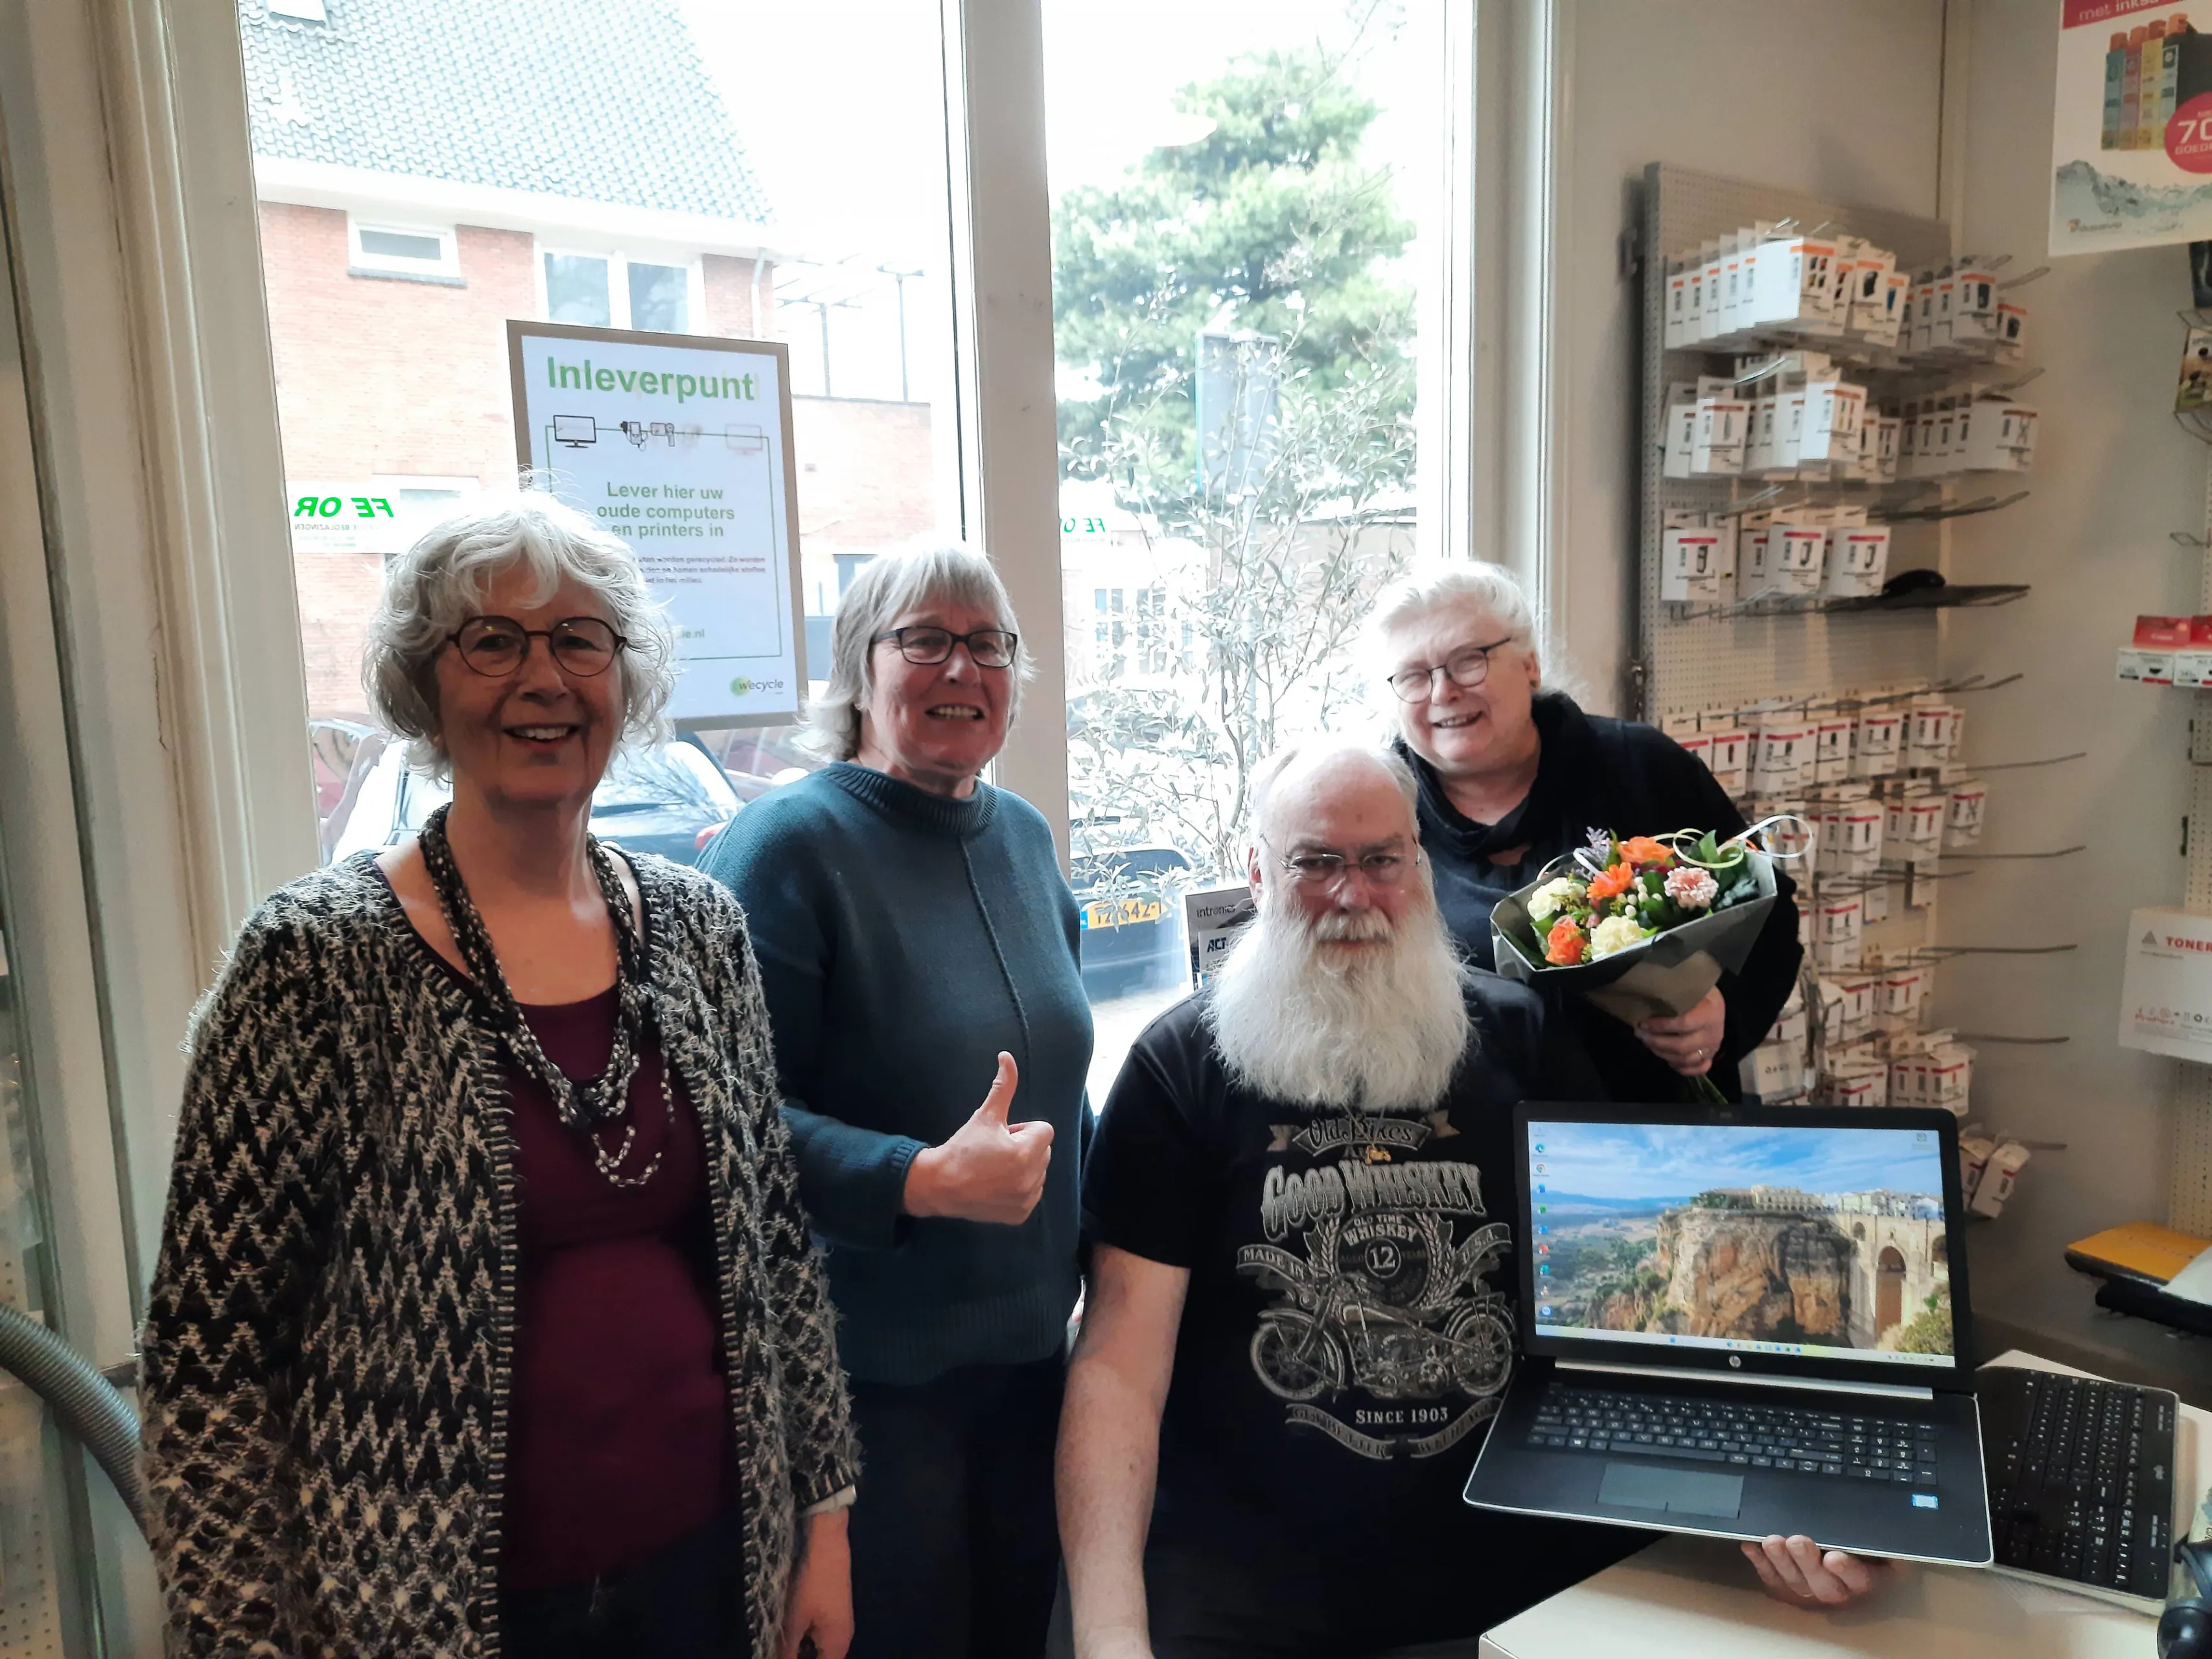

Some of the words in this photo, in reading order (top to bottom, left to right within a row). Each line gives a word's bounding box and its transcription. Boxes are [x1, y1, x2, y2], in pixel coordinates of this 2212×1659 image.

[2079, 5, 2111, 21] met
[547, 356, 755, 404] Inleverpunt
[607, 481, 658, 498] Lever
[664, 484, 697, 499] hier
[701, 487, 723, 499] uw
[596, 504, 640, 518] oude
[647, 505, 735, 521] computers
[611, 524, 632, 537] en
[638, 523, 703, 539] printers
[709, 523, 724, 537] in
[739, 679, 784, 692] wecycle
[1207, 936, 1227, 953] ACT
[1309, 1117, 1340, 1149] Old
[1342, 1112, 1413, 1143] Bikes
[1260, 1165, 1346, 1244] GOOD
[1338, 1159, 1487, 1218] WHISKEY
[1353, 1215, 1373, 1227] OLD
[1375, 1214, 1403, 1224] TIME
[1342, 1224, 1418, 1247] WHISKEY
[1244, 1248, 1285, 1270] MADE
[1369, 1246, 1396, 1270] 12
[1355, 1409, 1404, 1424] SINCE
[1411, 1407, 1449, 1423] 1903
